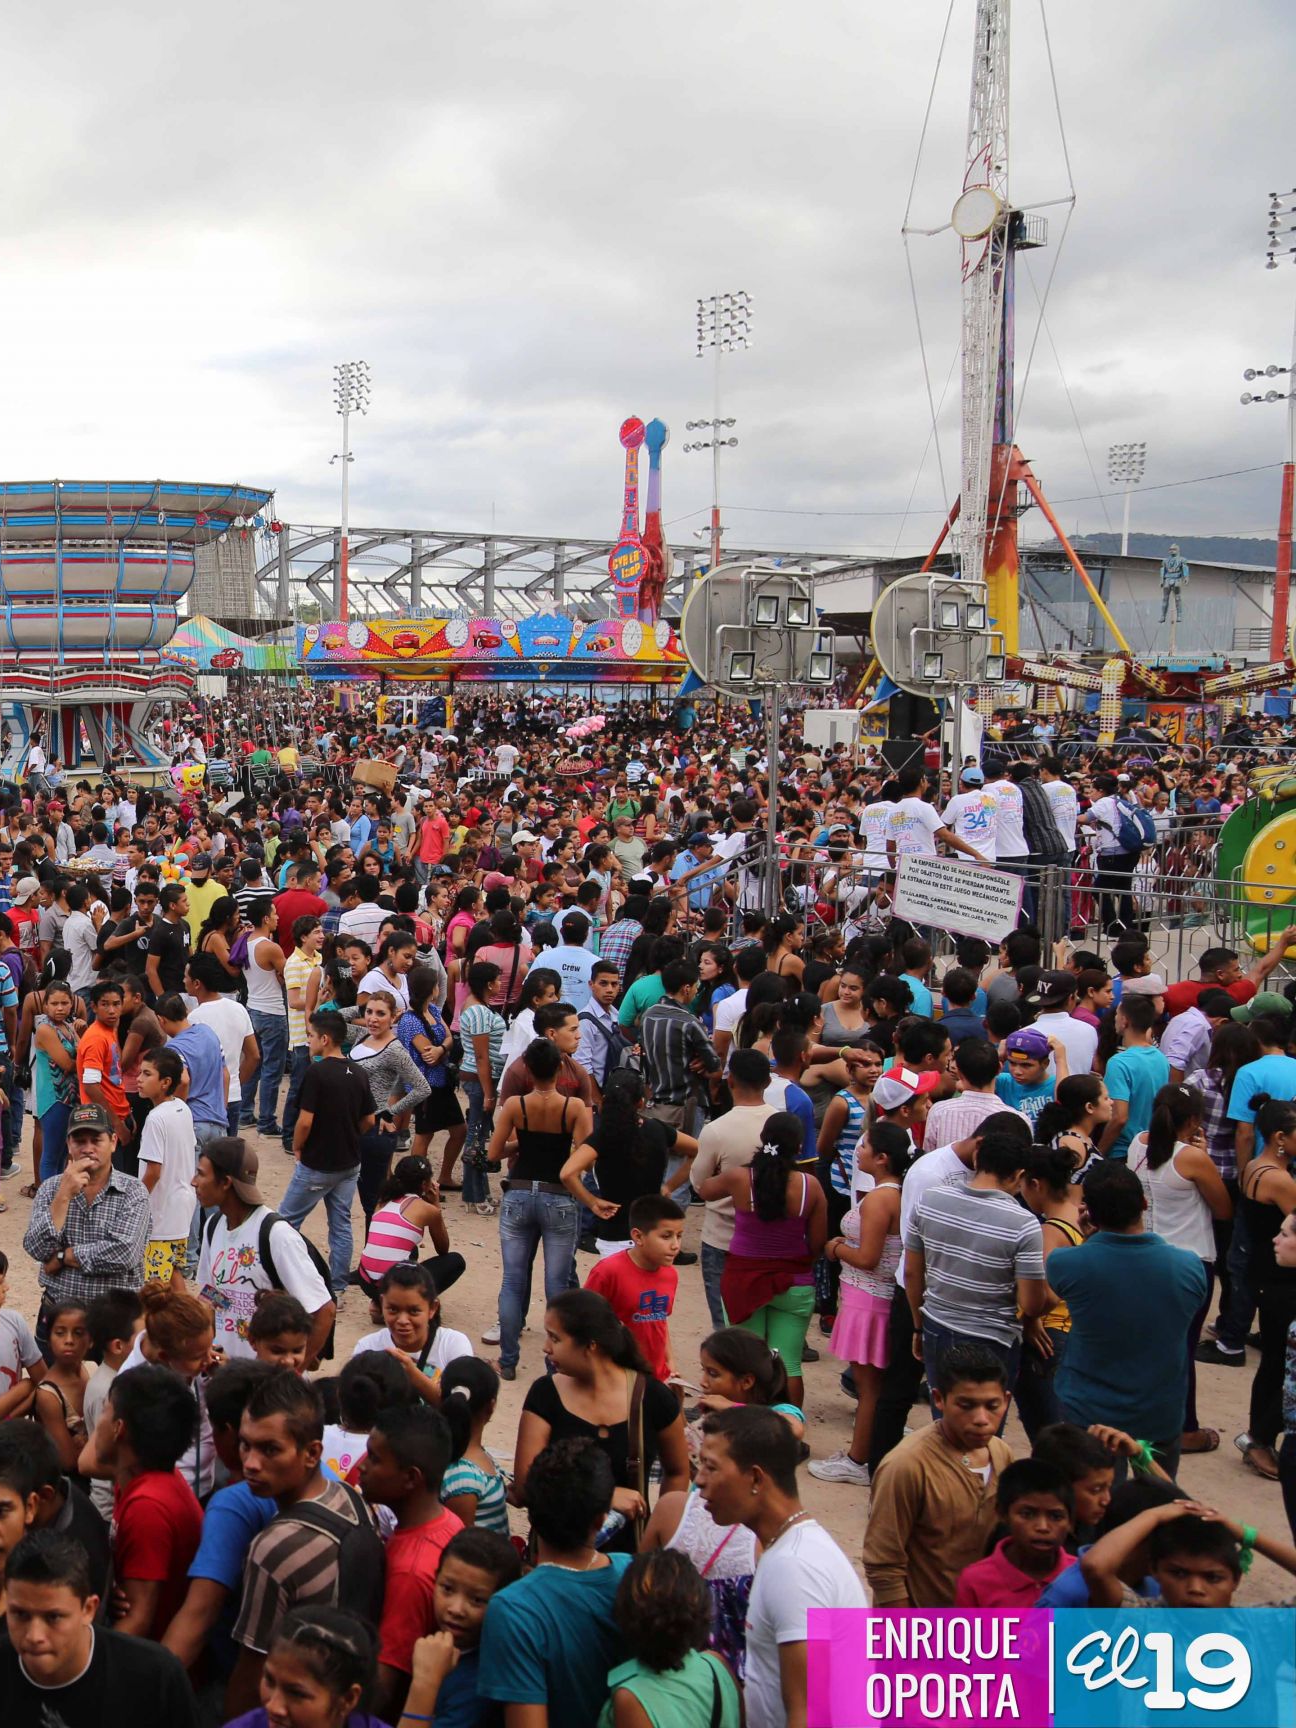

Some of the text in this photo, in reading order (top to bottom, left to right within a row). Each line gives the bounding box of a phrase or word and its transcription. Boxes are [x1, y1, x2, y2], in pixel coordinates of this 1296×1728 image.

[909, 866, 920, 874] POR
[920, 869, 943, 879] OBJETOS
[943, 874, 954, 882] QUE
[962, 878, 984, 890] PIERDAN
[985, 884, 1011, 896] DURANTE
[918, 859, 942, 869] EMPRESA
[958, 868, 973, 877] HACE
[973, 872, 1011, 886] RESPONSABLE
[907, 875, 932, 886] ESTANCIA
[939, 883, 953, 892] ESTE
[953, 887, 971, 896] JUEGO
[561, 963, 581, 972] Crew
[1036, 980, 1052, 994] NY
